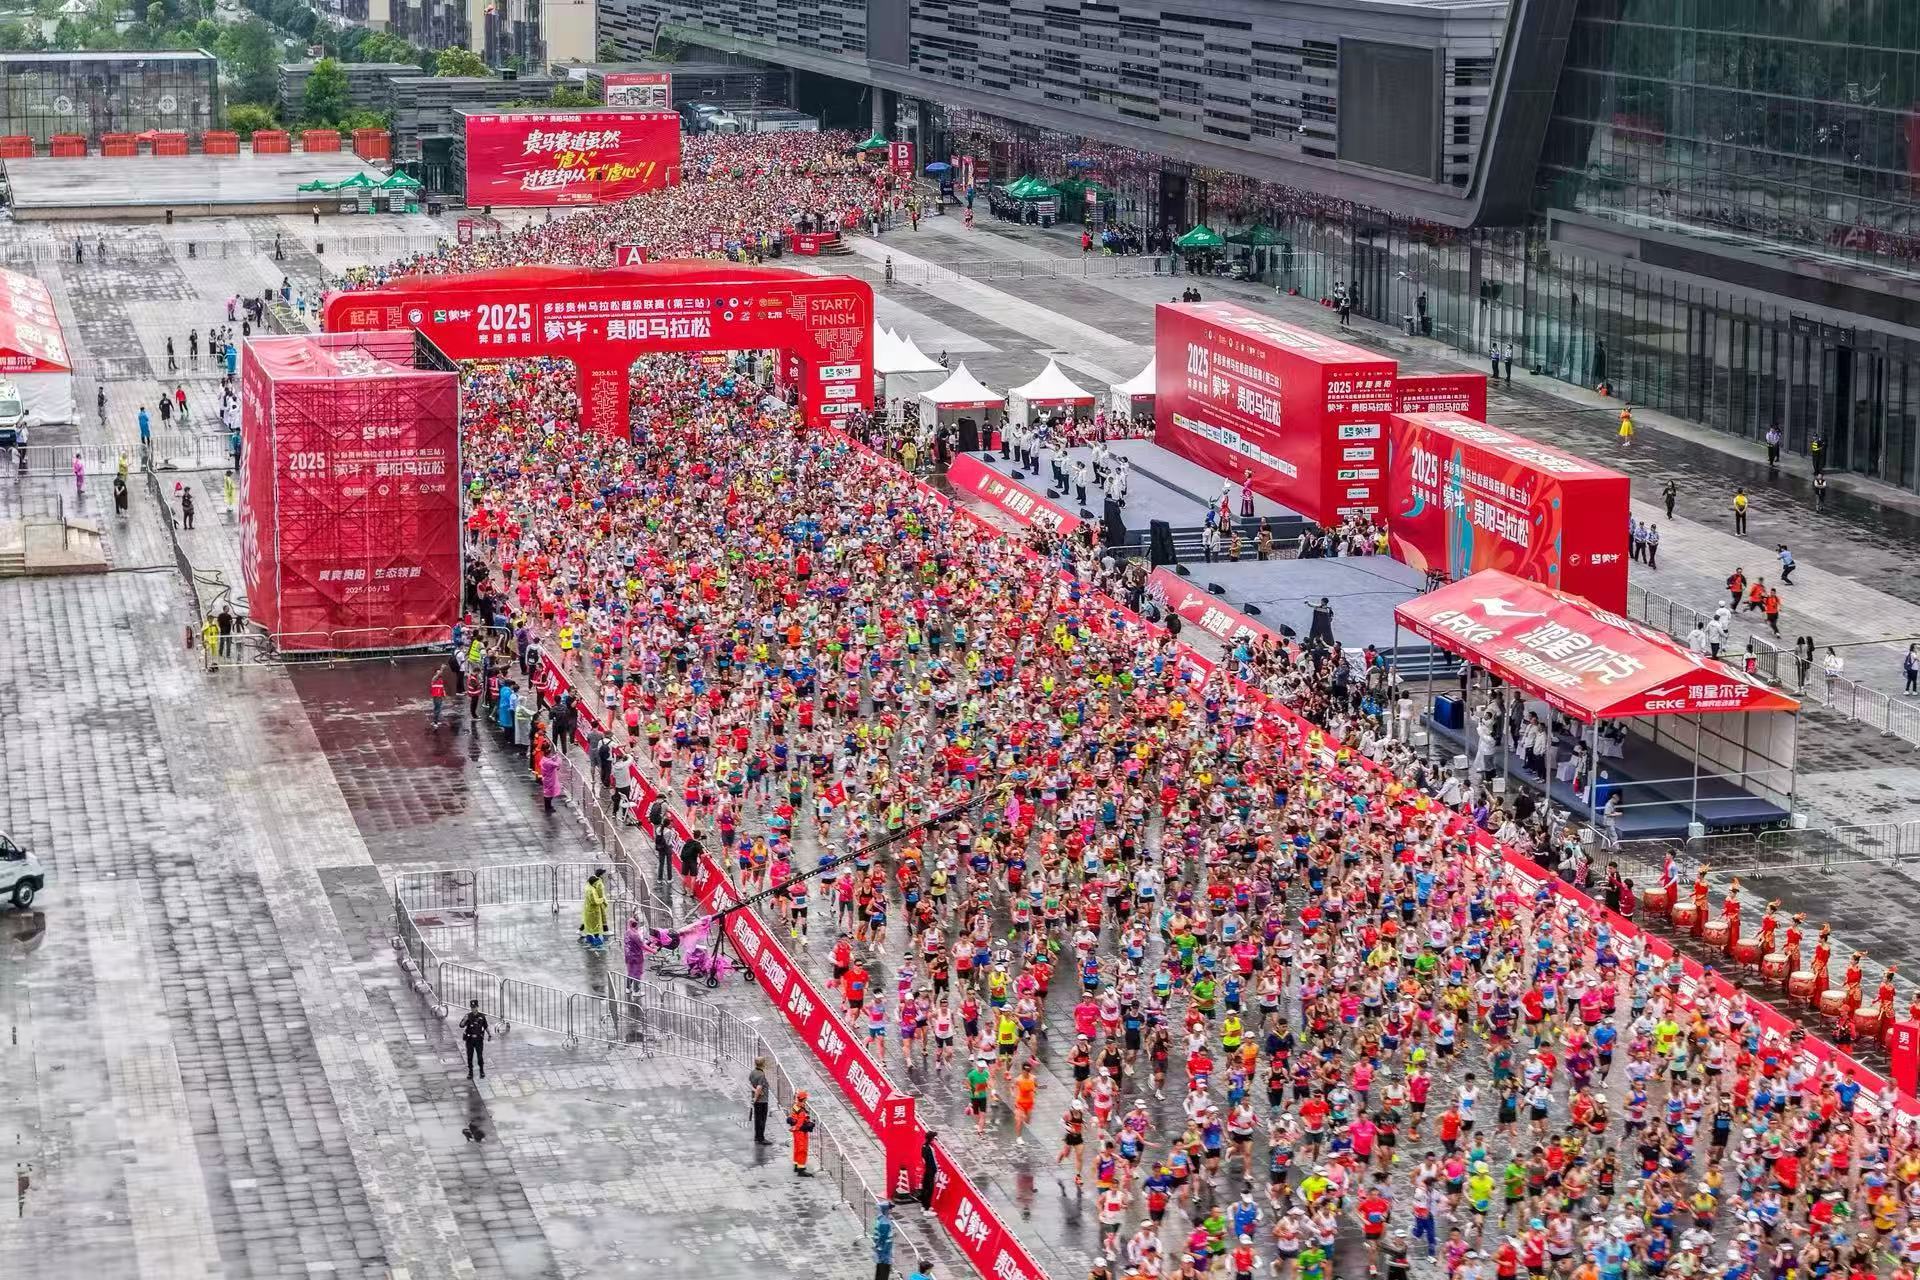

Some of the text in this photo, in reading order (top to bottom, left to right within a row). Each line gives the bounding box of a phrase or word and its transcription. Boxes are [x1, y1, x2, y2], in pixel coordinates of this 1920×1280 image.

[520, 129, 621, 156] 贵马赛道虽然
[898, 145, 909, 159] B
[626, 246, 643, 266] A
[350, 310, 379, 326] 起点
[448, 310, 471, 322] 蒙牛
[477, 303, 531, 331] 2025
[811, 313, 856, 326] FINISH
[1187, 342, 1209, 379] 2025
[1328, 381, 1351, 394] 2025
[289, 452, 325, 471] 2025
[1411, 446, 1438, 488] 2025
[1601, 553, 1621, 565] 蒙牛
[1428, 610, 1503, 645] ERKE
[1513, 620, 1651, 686] 鸿星尔克
[1688, 684, 1749, 699] 鸿星尔克
[1645, 699, 1685, 710] ERKE
[1899, 1031, 1910, 1045] 男
[893, 1105, 906, 1119] 男
